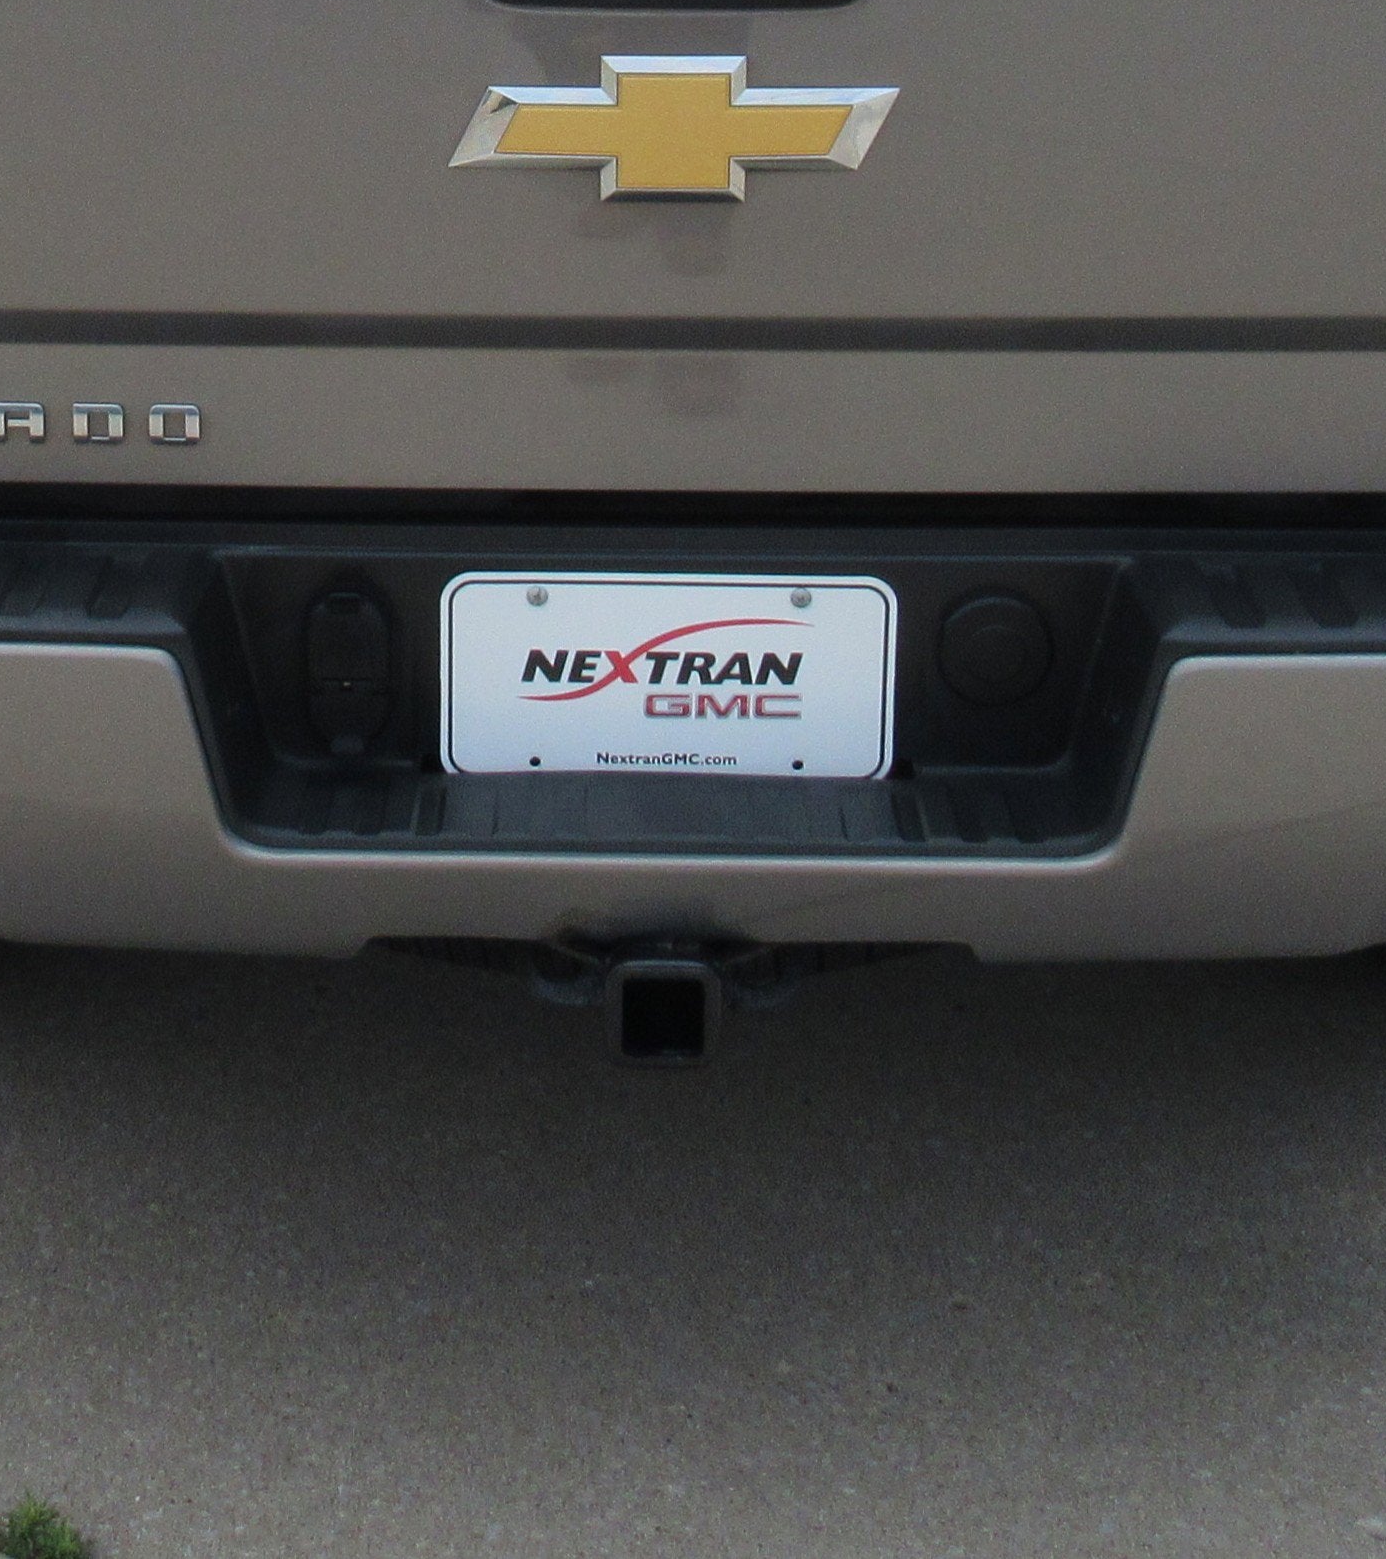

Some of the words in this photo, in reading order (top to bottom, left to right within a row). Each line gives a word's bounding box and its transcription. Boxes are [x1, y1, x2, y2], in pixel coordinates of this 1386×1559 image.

[521, 647, 804, 686] NEXTRAN
[643, 693, 803, 719] GMC
[596, 751, 738, 767] NextranGMC.com
